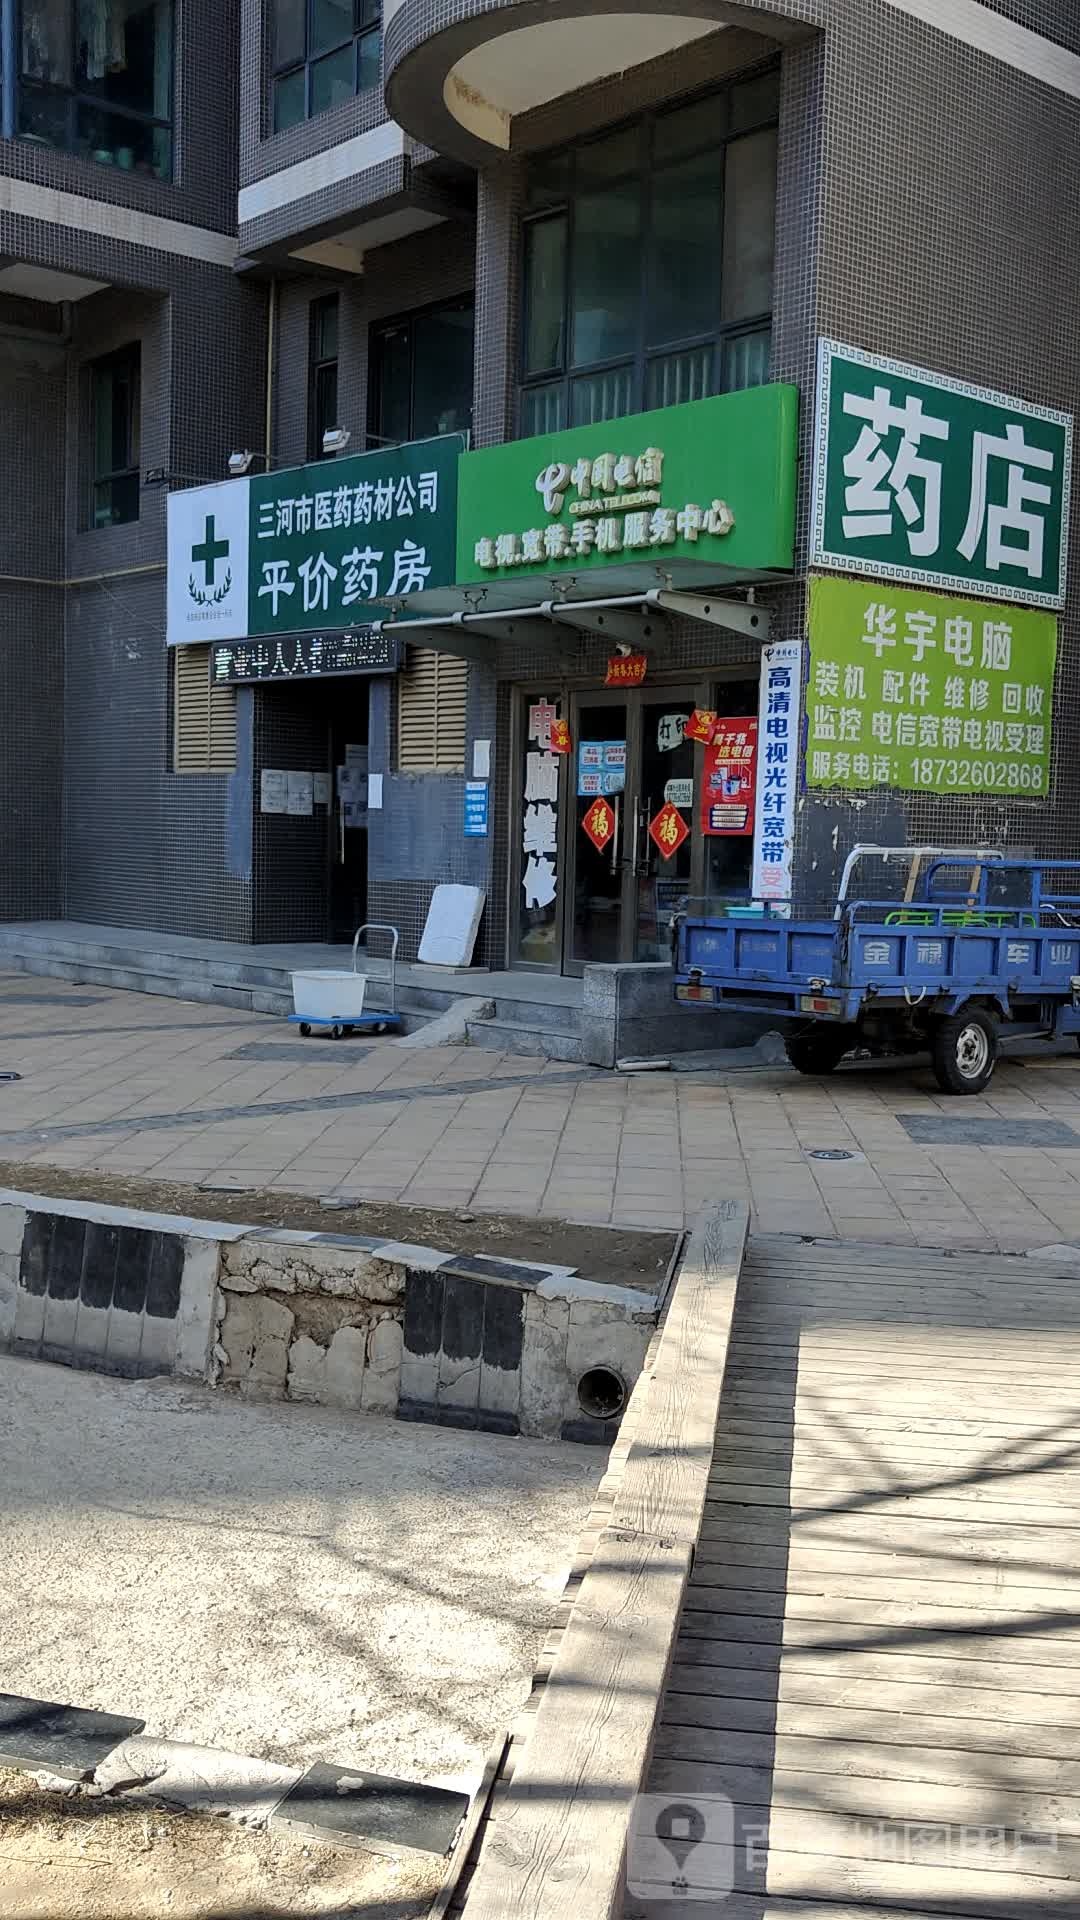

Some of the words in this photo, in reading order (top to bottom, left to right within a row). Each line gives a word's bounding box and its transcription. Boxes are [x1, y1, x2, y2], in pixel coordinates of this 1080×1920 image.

[570, 447, 664, 498] 中国电信
[842, 386, 1054, 578] 药店
[257, 471, 439, 539] 三河市医药药材公司
[257, 539, 432, 617] 平价药房
[862, 603, 1013, 671] 华宇电脑
[814, 661, 867, 700] 装机
[882, 669, 930, 707] 配件
[943, 676, 989, 712] 维修
[1002, 683, 1045, 717] 回收
[813, 705, 863, 742] 监控
[871, 710, 1045, 755] 电信宽带电视受理
[910, 757, 1042, 789] 18732602868
[591, 807, 609, 837] 福
[660, 813, 678, 845] 福
